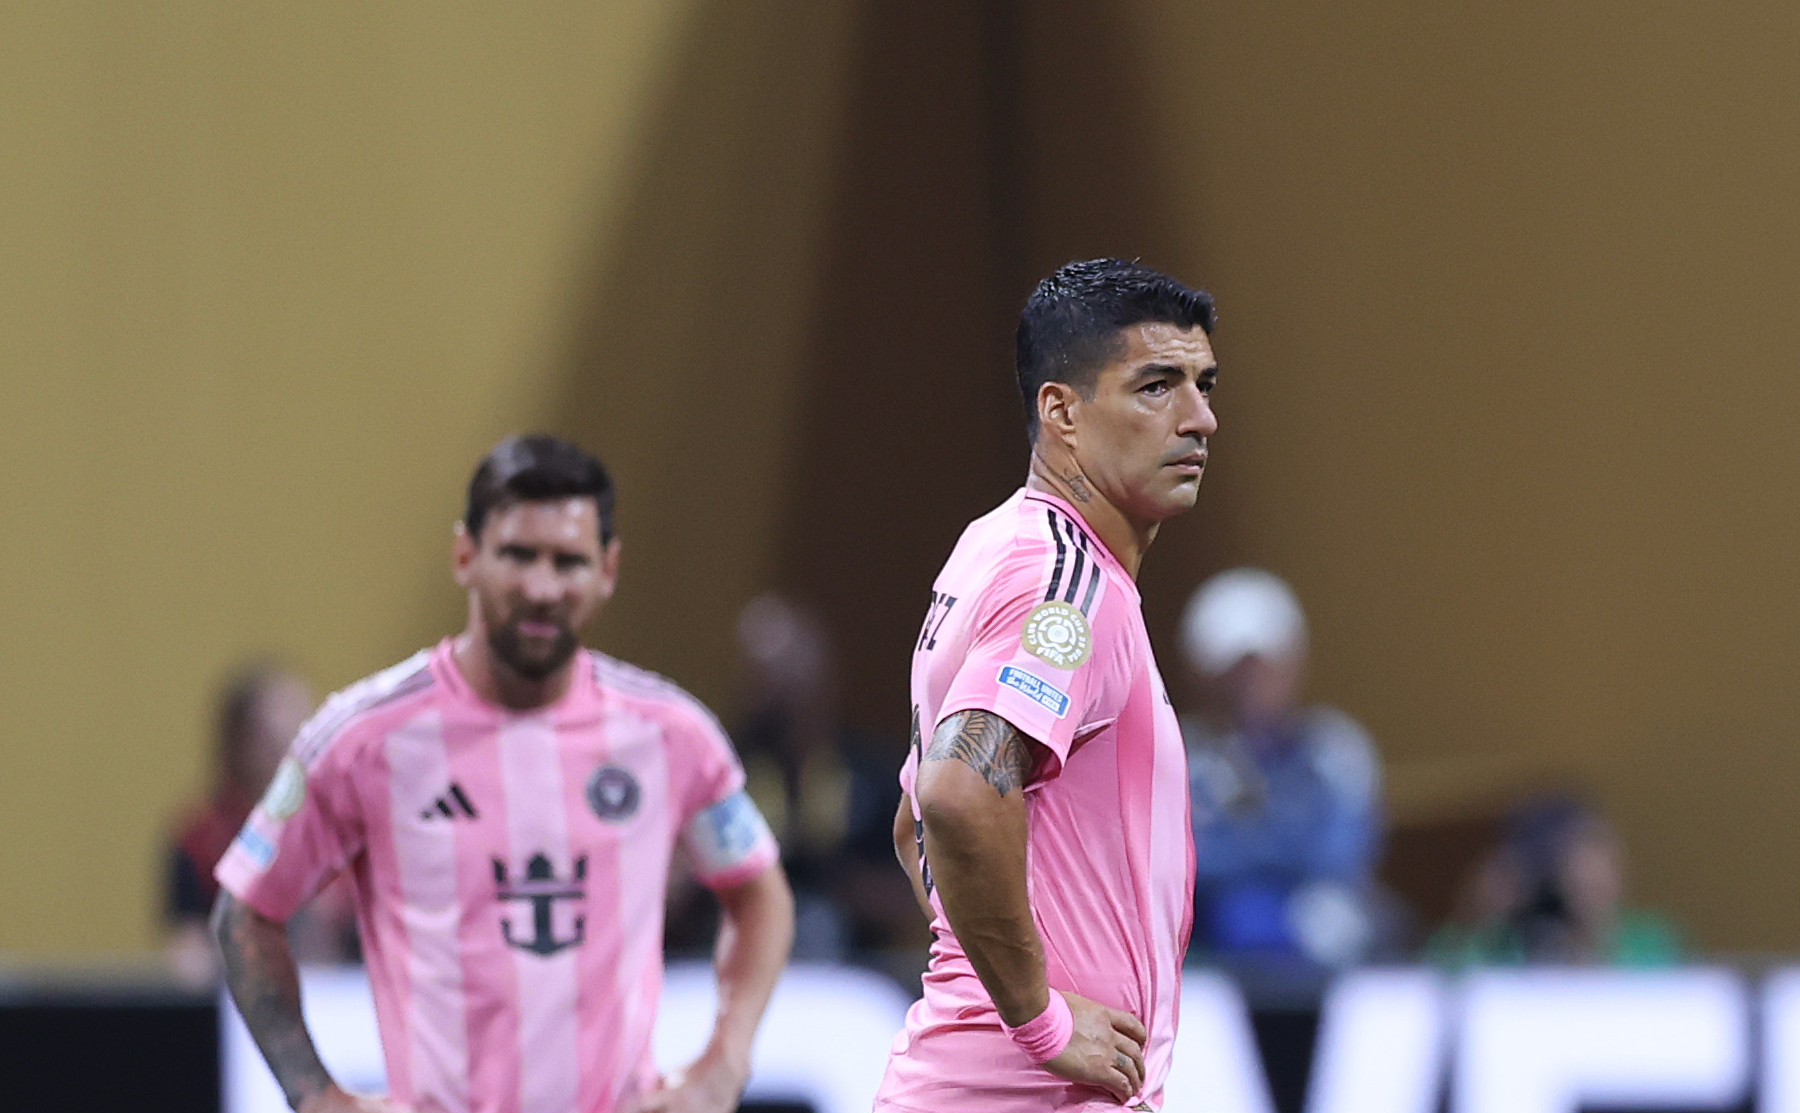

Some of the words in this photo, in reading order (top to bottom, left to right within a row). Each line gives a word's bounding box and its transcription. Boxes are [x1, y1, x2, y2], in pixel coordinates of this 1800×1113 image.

[1032, 606, 1069, 622] WORLD
[1070, 613, 1085, 634] CUP
[1027, 622, 1038, 645] CLUB
[1036, 646, 1066, 666] FIFA
